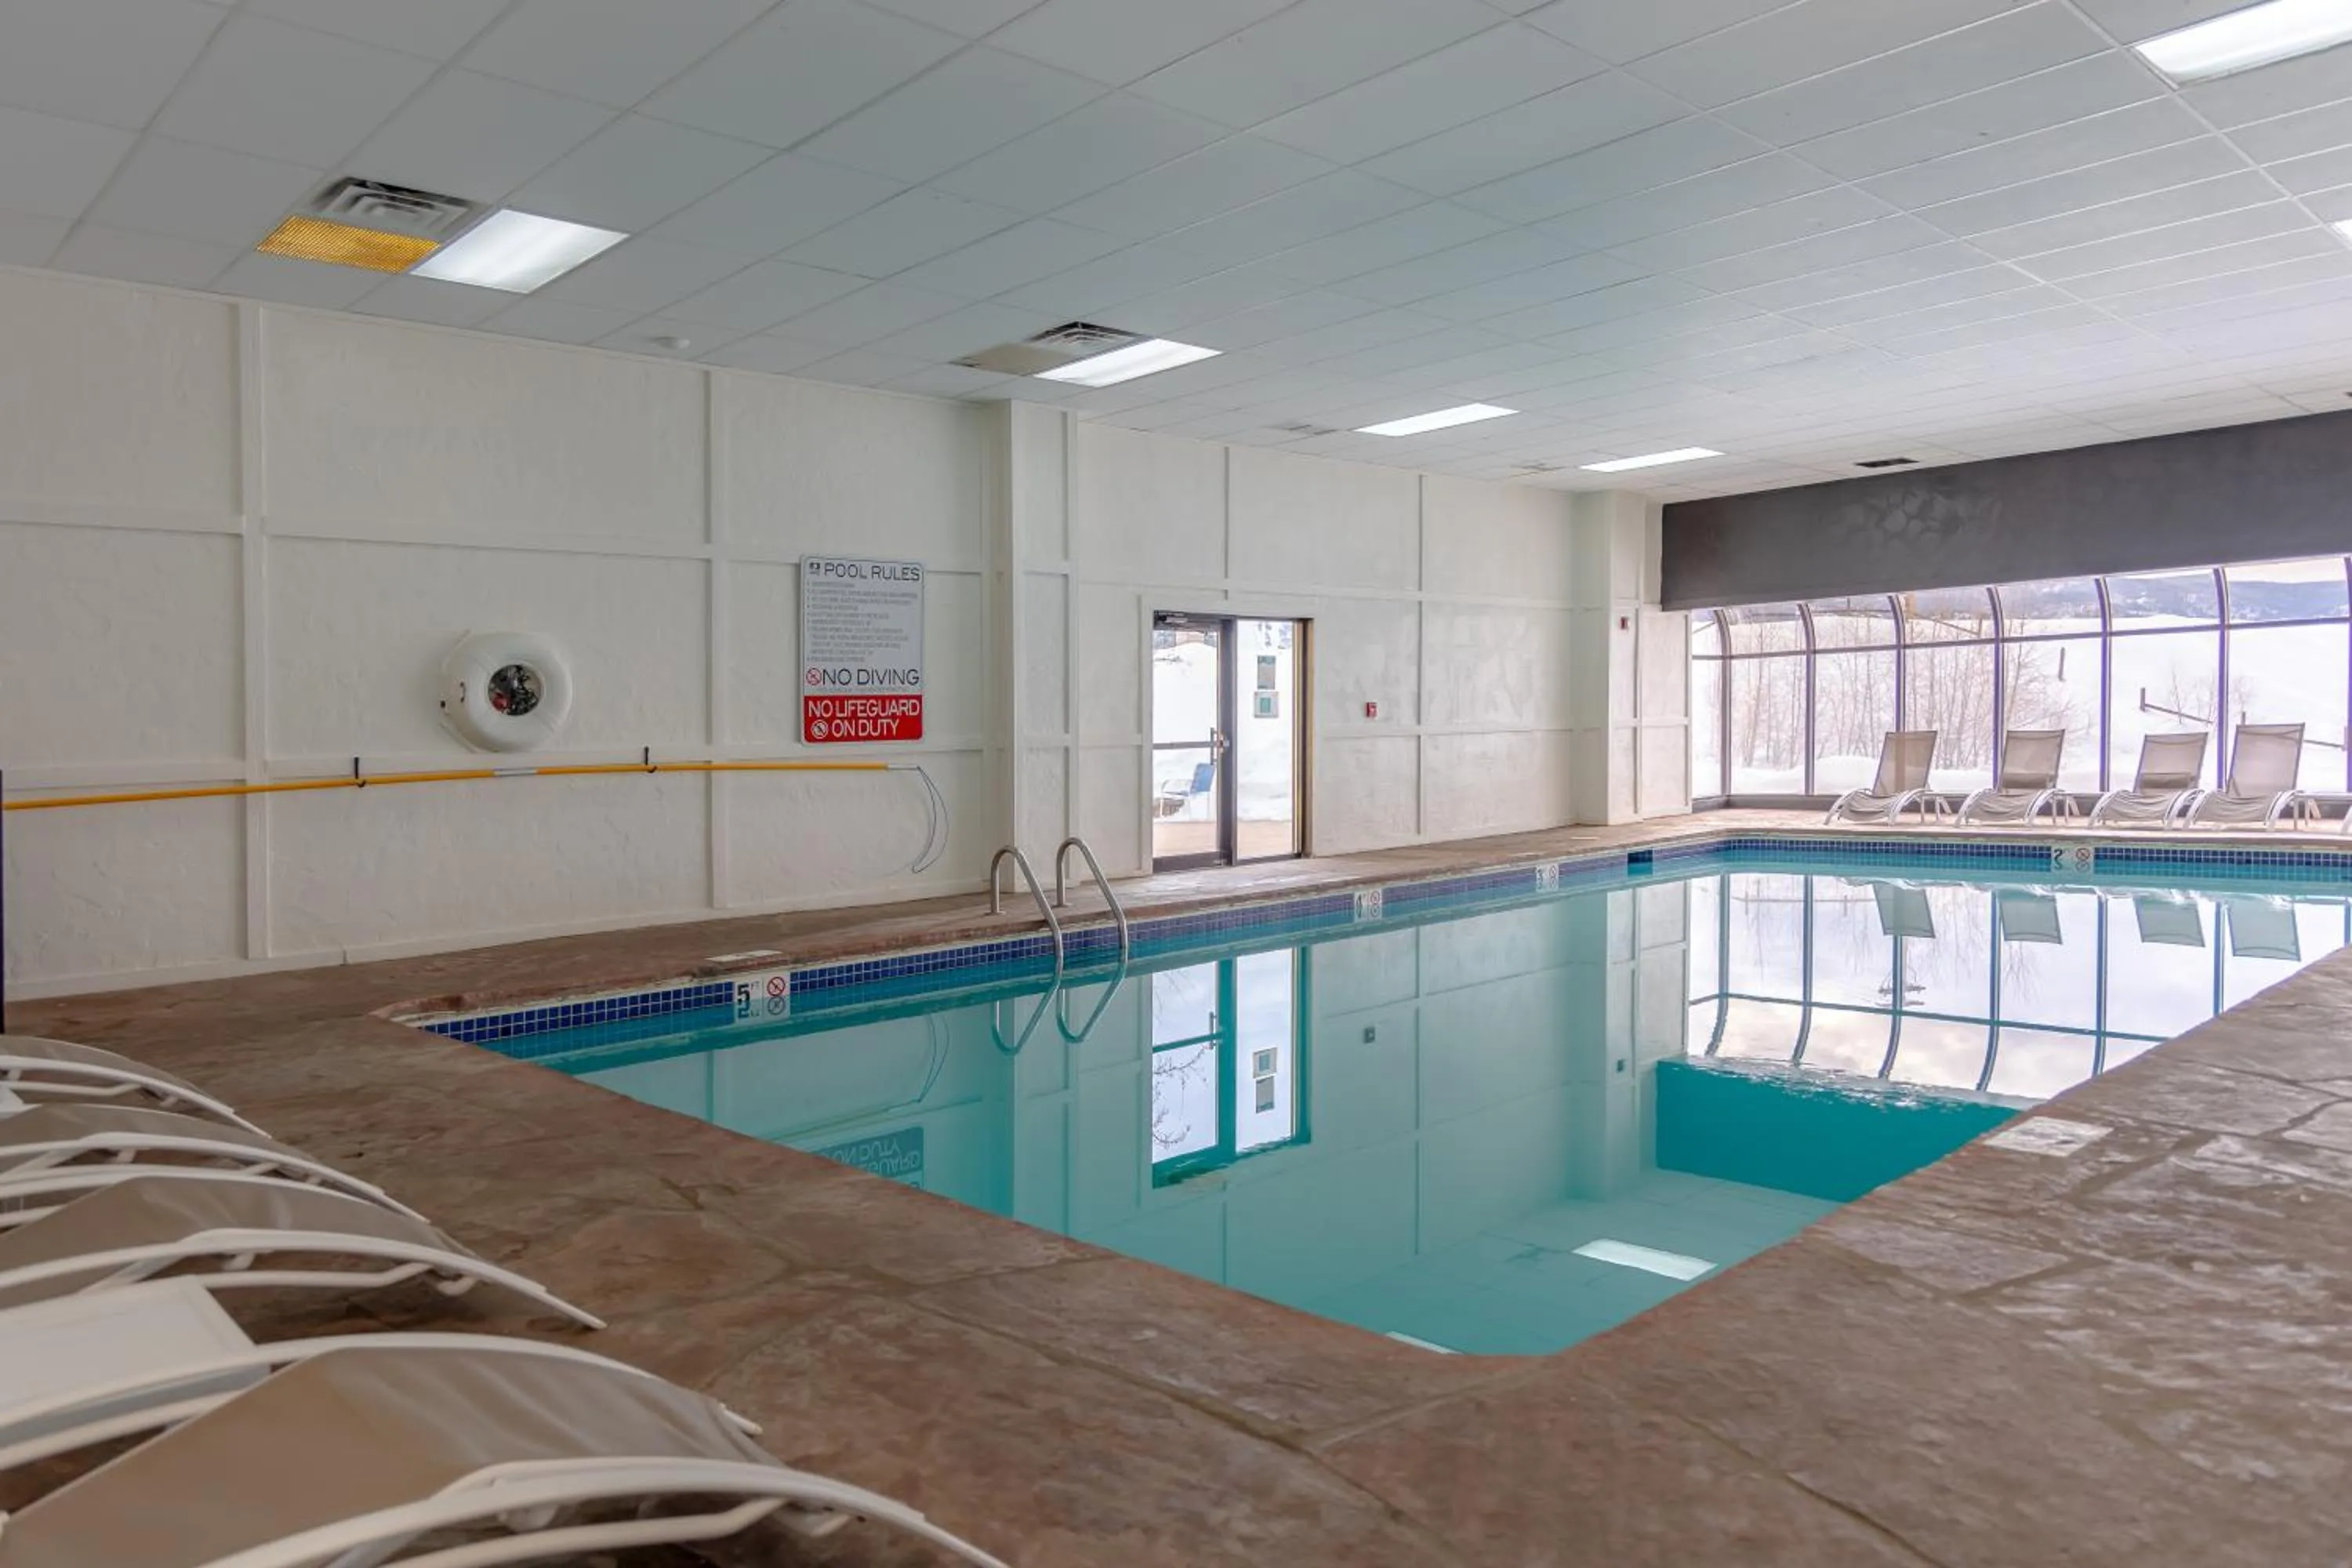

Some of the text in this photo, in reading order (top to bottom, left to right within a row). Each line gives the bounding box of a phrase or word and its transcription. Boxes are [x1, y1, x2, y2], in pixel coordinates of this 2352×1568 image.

[823, 562, 920, 581] POOL RULES
[822, 669, 920, 685] NO DIVING
[808, 699, 920, 717] NO LIFEGUARD
[832, 719, 899, 736] ON DUTY
[737, 984, 750, 1004] 5
